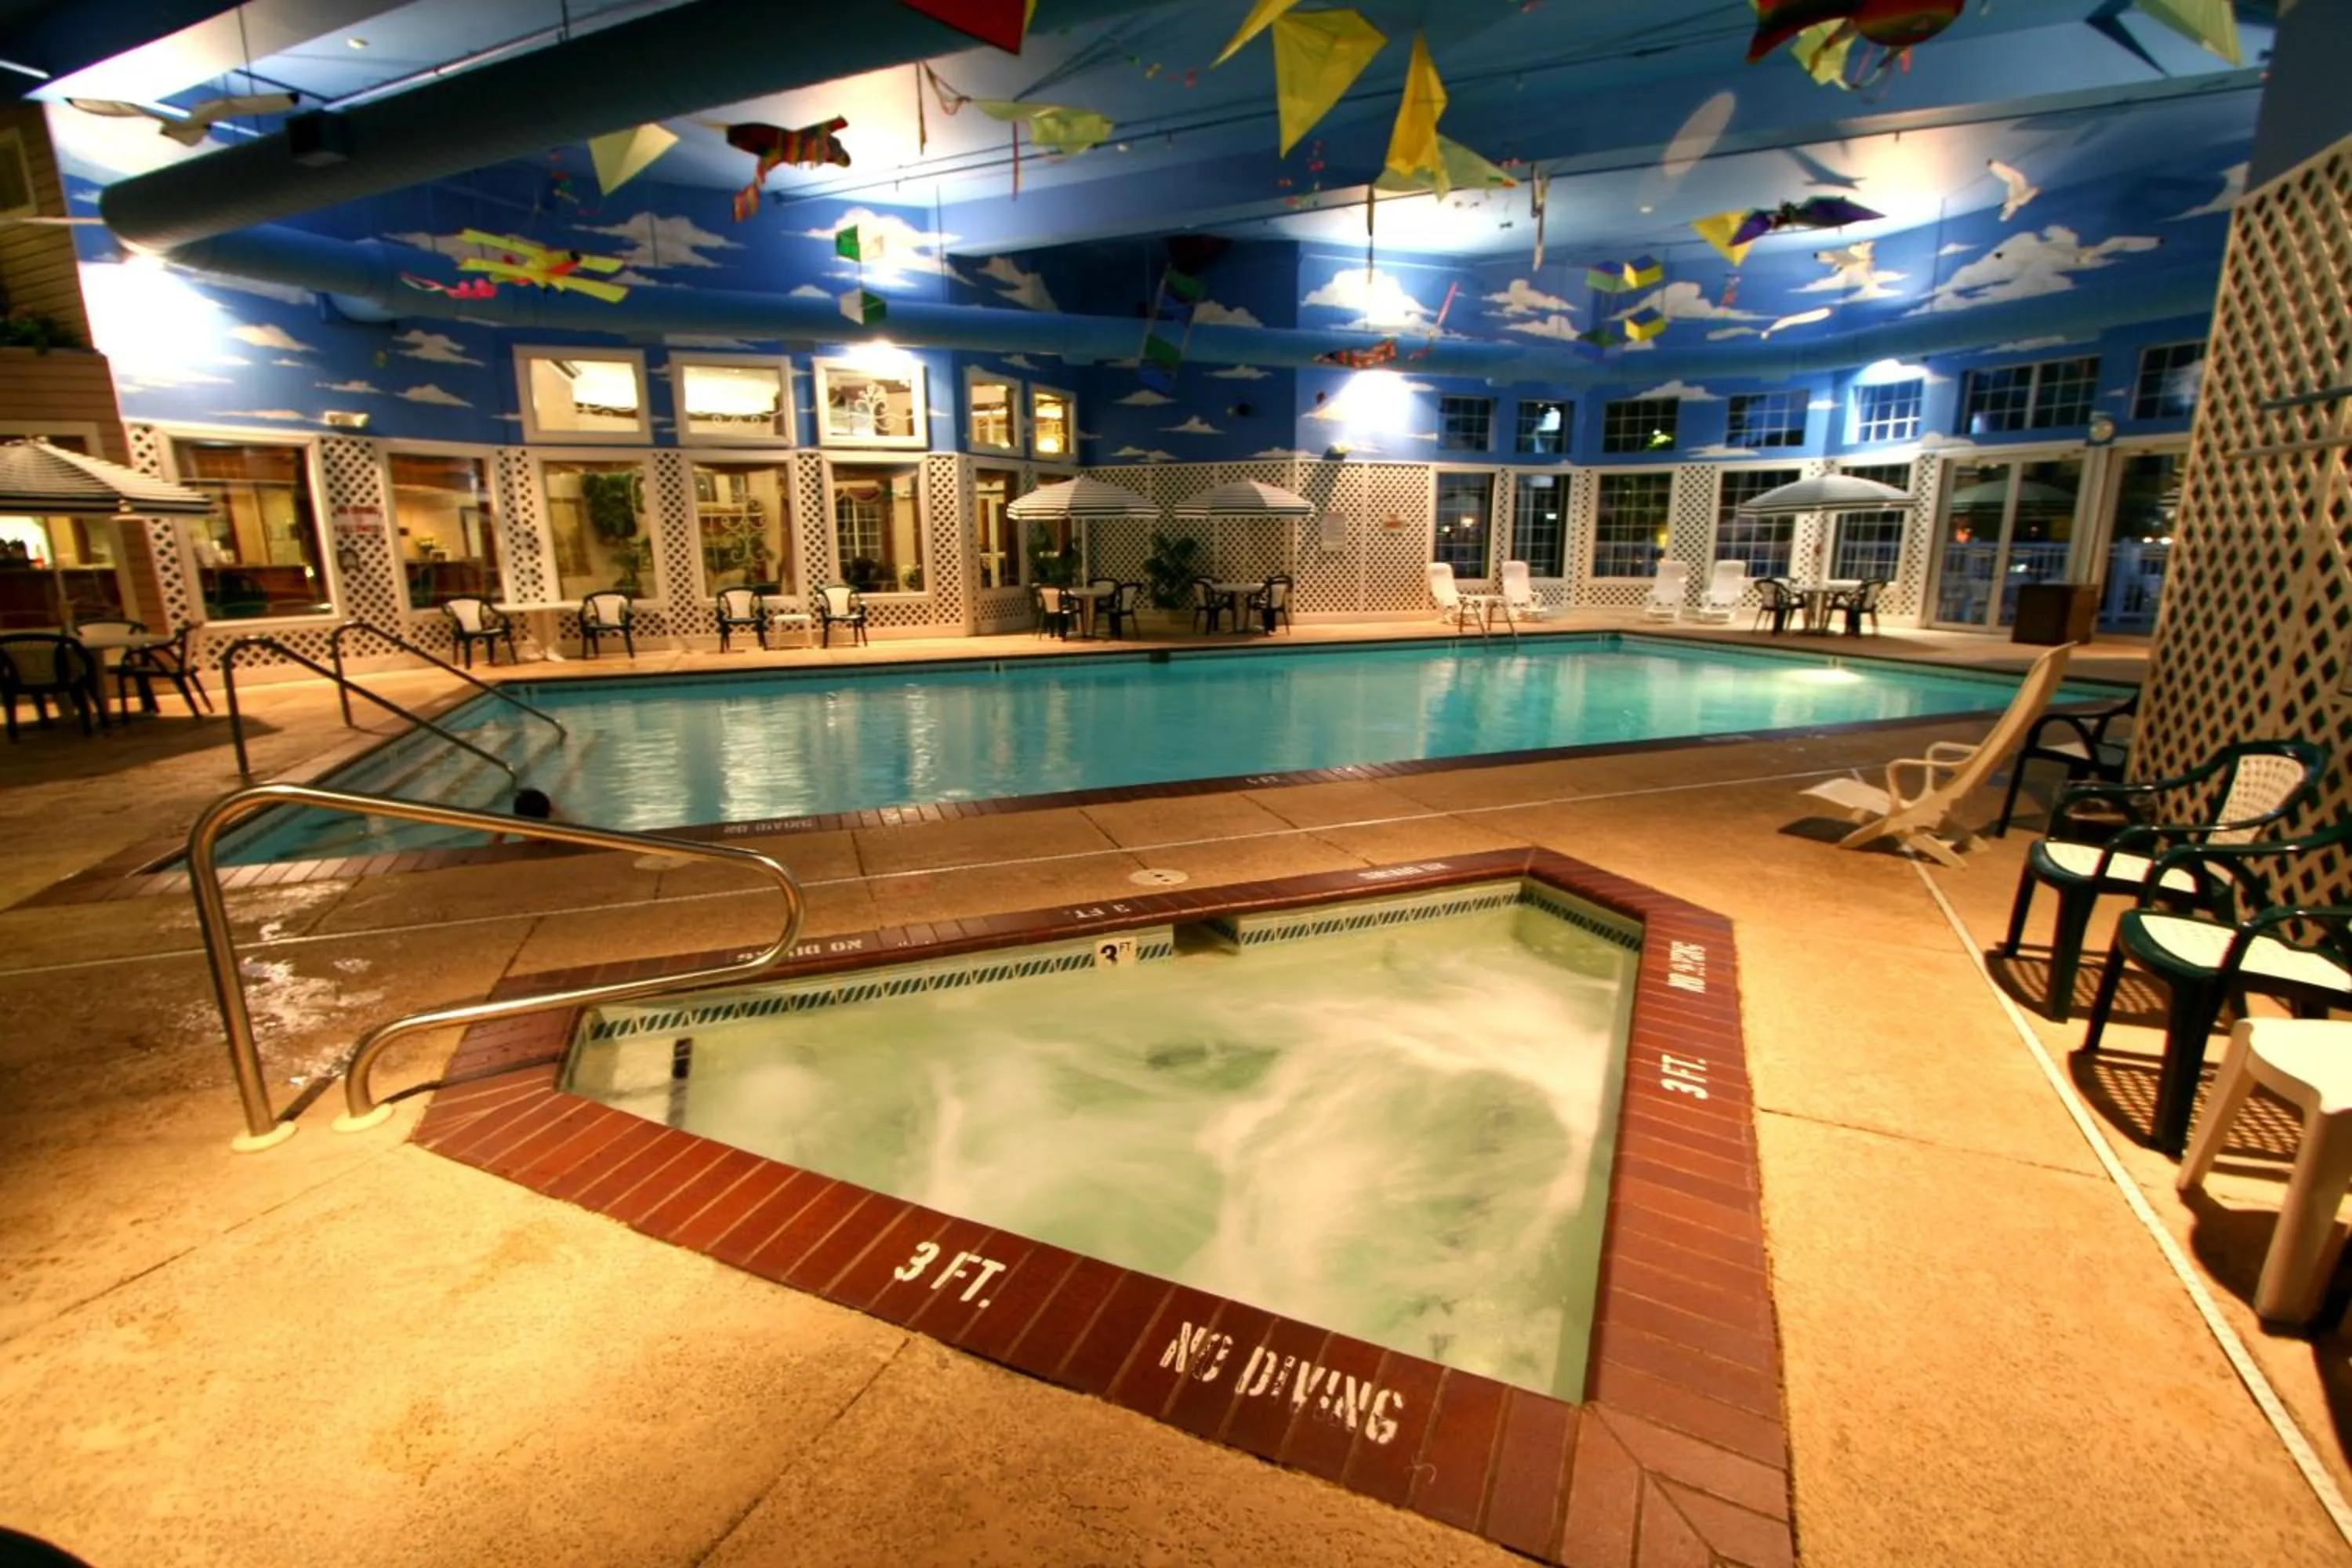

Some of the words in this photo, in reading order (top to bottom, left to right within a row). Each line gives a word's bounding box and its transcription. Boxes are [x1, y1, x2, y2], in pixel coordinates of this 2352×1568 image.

[1100, 943, 1118, 965] 3
[1661, 1053, 1708, 1083] FT.
[1661, 1078, 1708, 1099] 3
[894, 1241, 940, 1282] 3
[930, 1251, 1007, 1308] FT.
[1159, 1321, 1233, 1382] NO
[1234, 1345, 1403, 1445] DIVING
